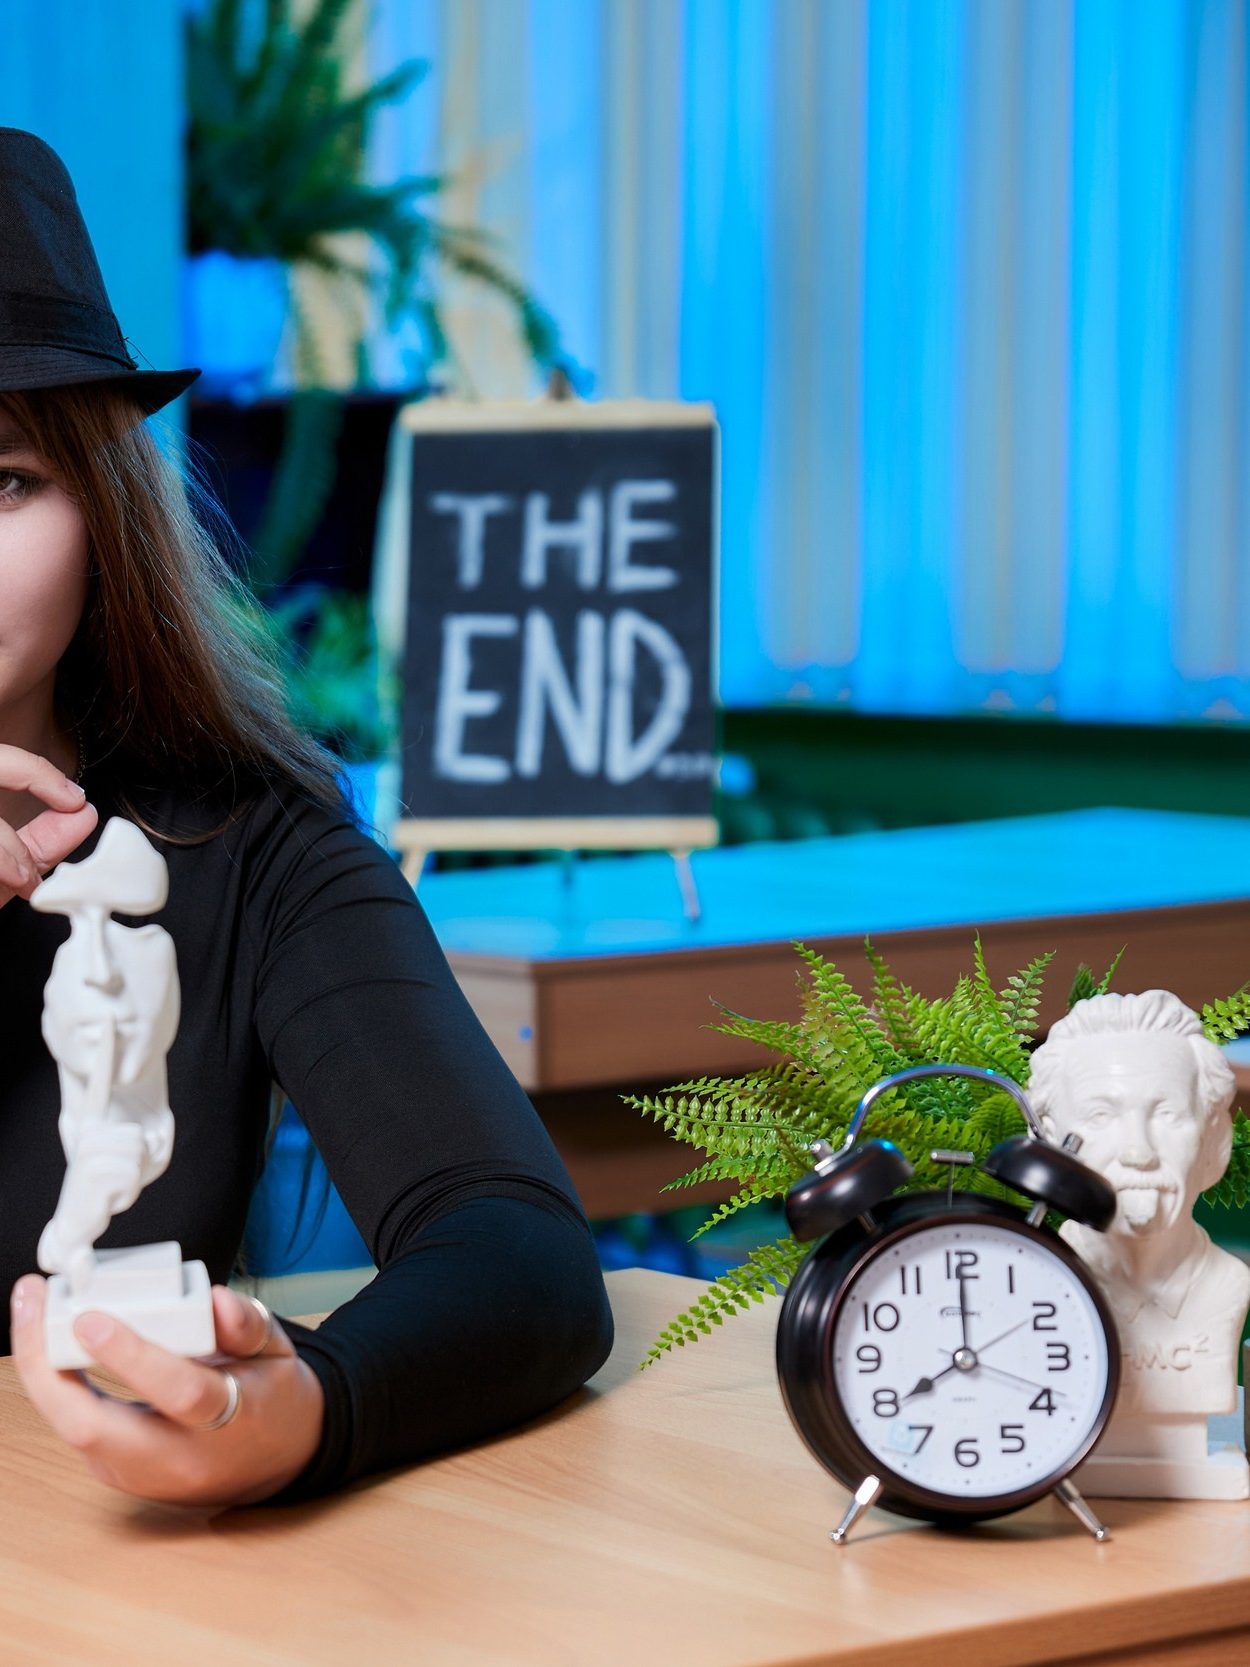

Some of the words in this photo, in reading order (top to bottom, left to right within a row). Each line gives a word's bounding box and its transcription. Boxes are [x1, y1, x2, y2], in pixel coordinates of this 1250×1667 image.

[430, 478, 679, 594] THE
[900, 1265, 922, 1295] 11
[945, 1251, 980, 1280] 12
[1008, 1265, 1014, 1294] 1
[863, 1302, 900, 1332] 10
[1032, 1302, 1058, 1331] 2
[856, 1345, 882, 1374] 9
[1046, 1343, 1071, 1371] 3
[873, 1389, 900, 1418] 8
[1028, 1388, 1057, 1416] 4
[908, 1425, 934, 1454] 7
[954, 1439, 981, 1468] 6
[1000, 1425, 1025, 1453] 5
